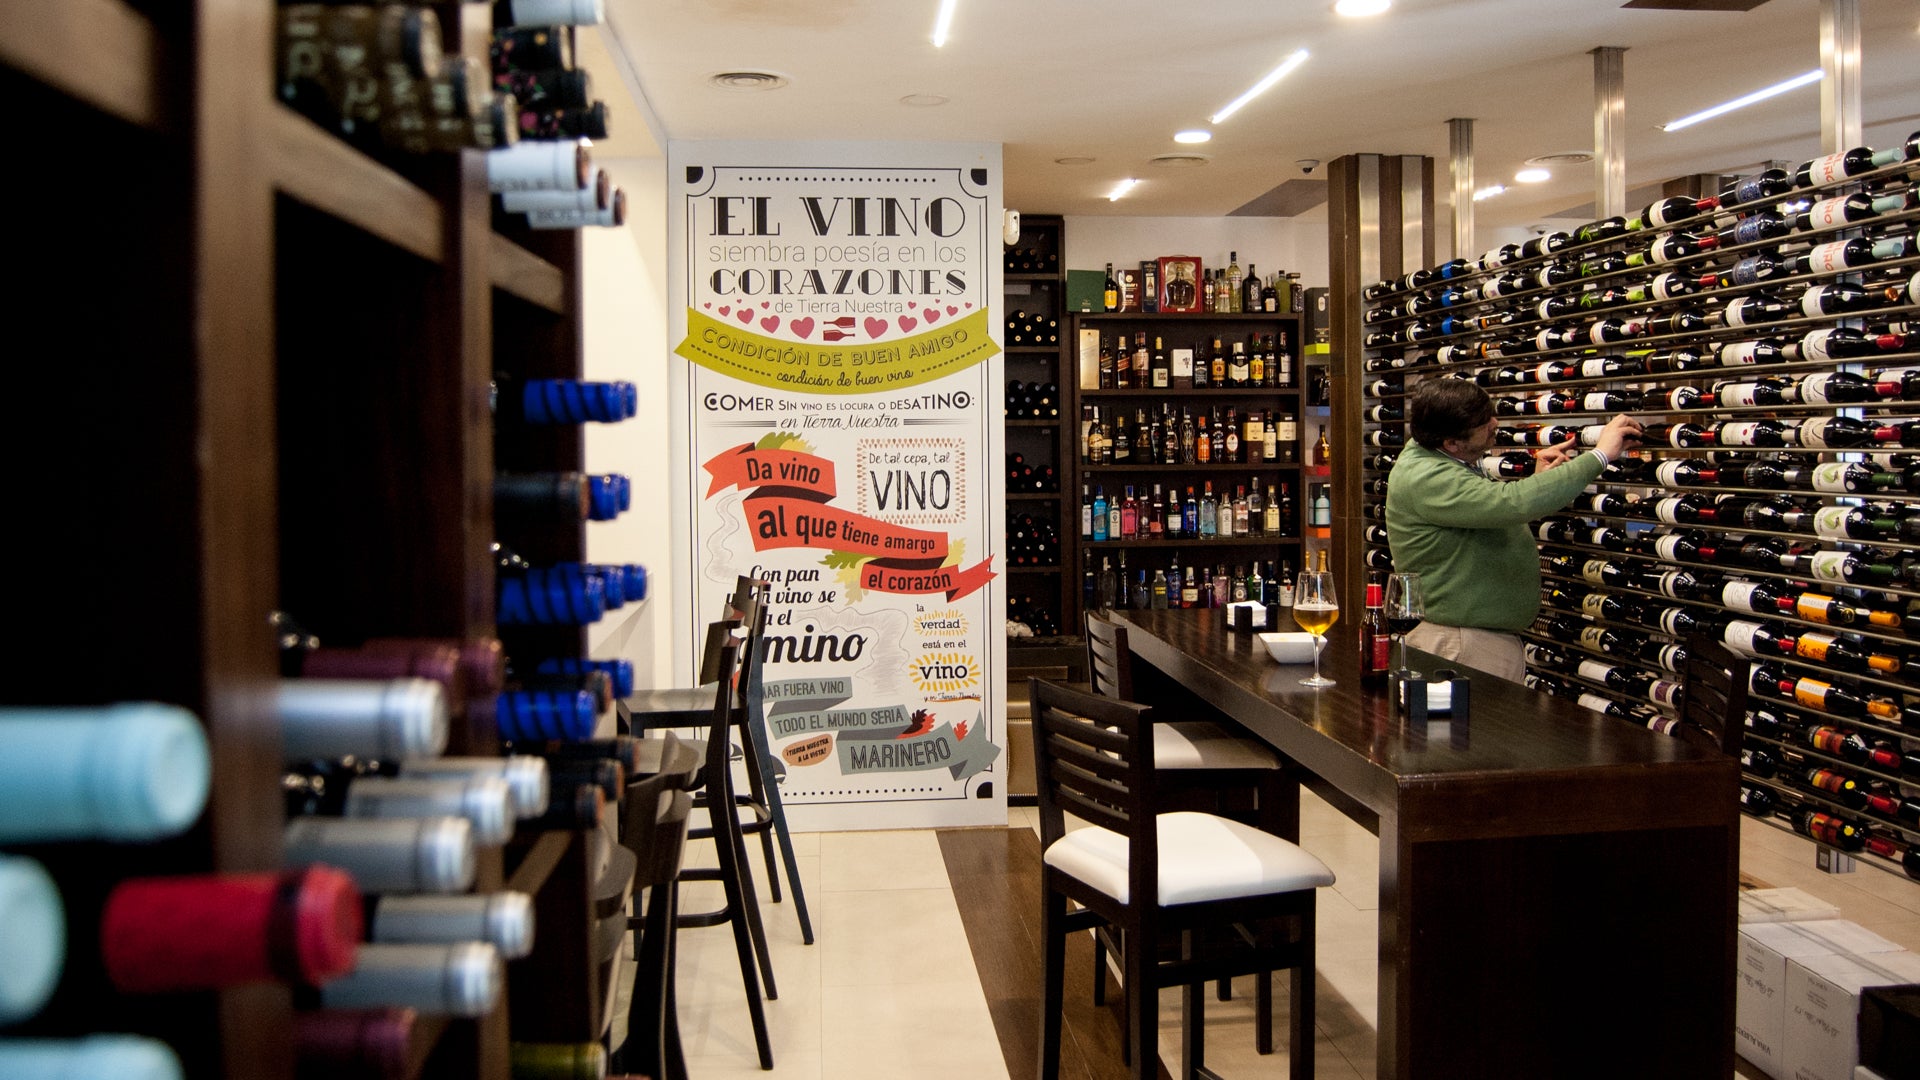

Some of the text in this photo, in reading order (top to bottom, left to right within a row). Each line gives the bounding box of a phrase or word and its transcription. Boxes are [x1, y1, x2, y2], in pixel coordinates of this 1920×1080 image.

[709, 196, 966, 238] EL VINO
[709, 240, 966, 266] siembra poesía en los
[710, 268, 966, 296] CORAZONES
[774, 299, 903, 313] de Tierra Nuestra
[702, 328, 968, 366] CONDICIÓN DE BUEN AMIGO
[776, 370, 914, 386] condición de buen vino
[704, 392, 774, 411] COMER
[800, 402, 822, 410] VINO
[826, 402, 836, 410] ES
[840, 402, 874, 410] LOCURA
[878, 402, 886, 410] O
[780, 413, 900, 430] en Tierra Nuestra
[869, 451, 950, 466] De tal cepa, tal
[746, 457, 821, 485] Da vino
[870, 470, 951, 510] VINO
[757, 504, 936, 554] al que tiene amargo
[750, 564, 820, 588] Con pan
[868, 570, 951, 591] el corazón
[775, 590, 814, 604] vino
[818, 590, 836, 603] se
[916, 603, 924, 612] la
[777, 609, 793, 626] el
[920, 618, 961, 630] verdad
[737, 624, 868, 664] mino
[922, 640, 941, 649] está
[958, 640, 967, 648] el
[919, 661, 968, 680] vino
[784, 682, 816, 696] FUERA
[820, 680, 844, 695] VINO
[775, 708, 904, 734] TODO EL MUNDO SERIA
[806, 738, 829, 750] NUESTRA
[850, 736, 951, 770] MARINERO
